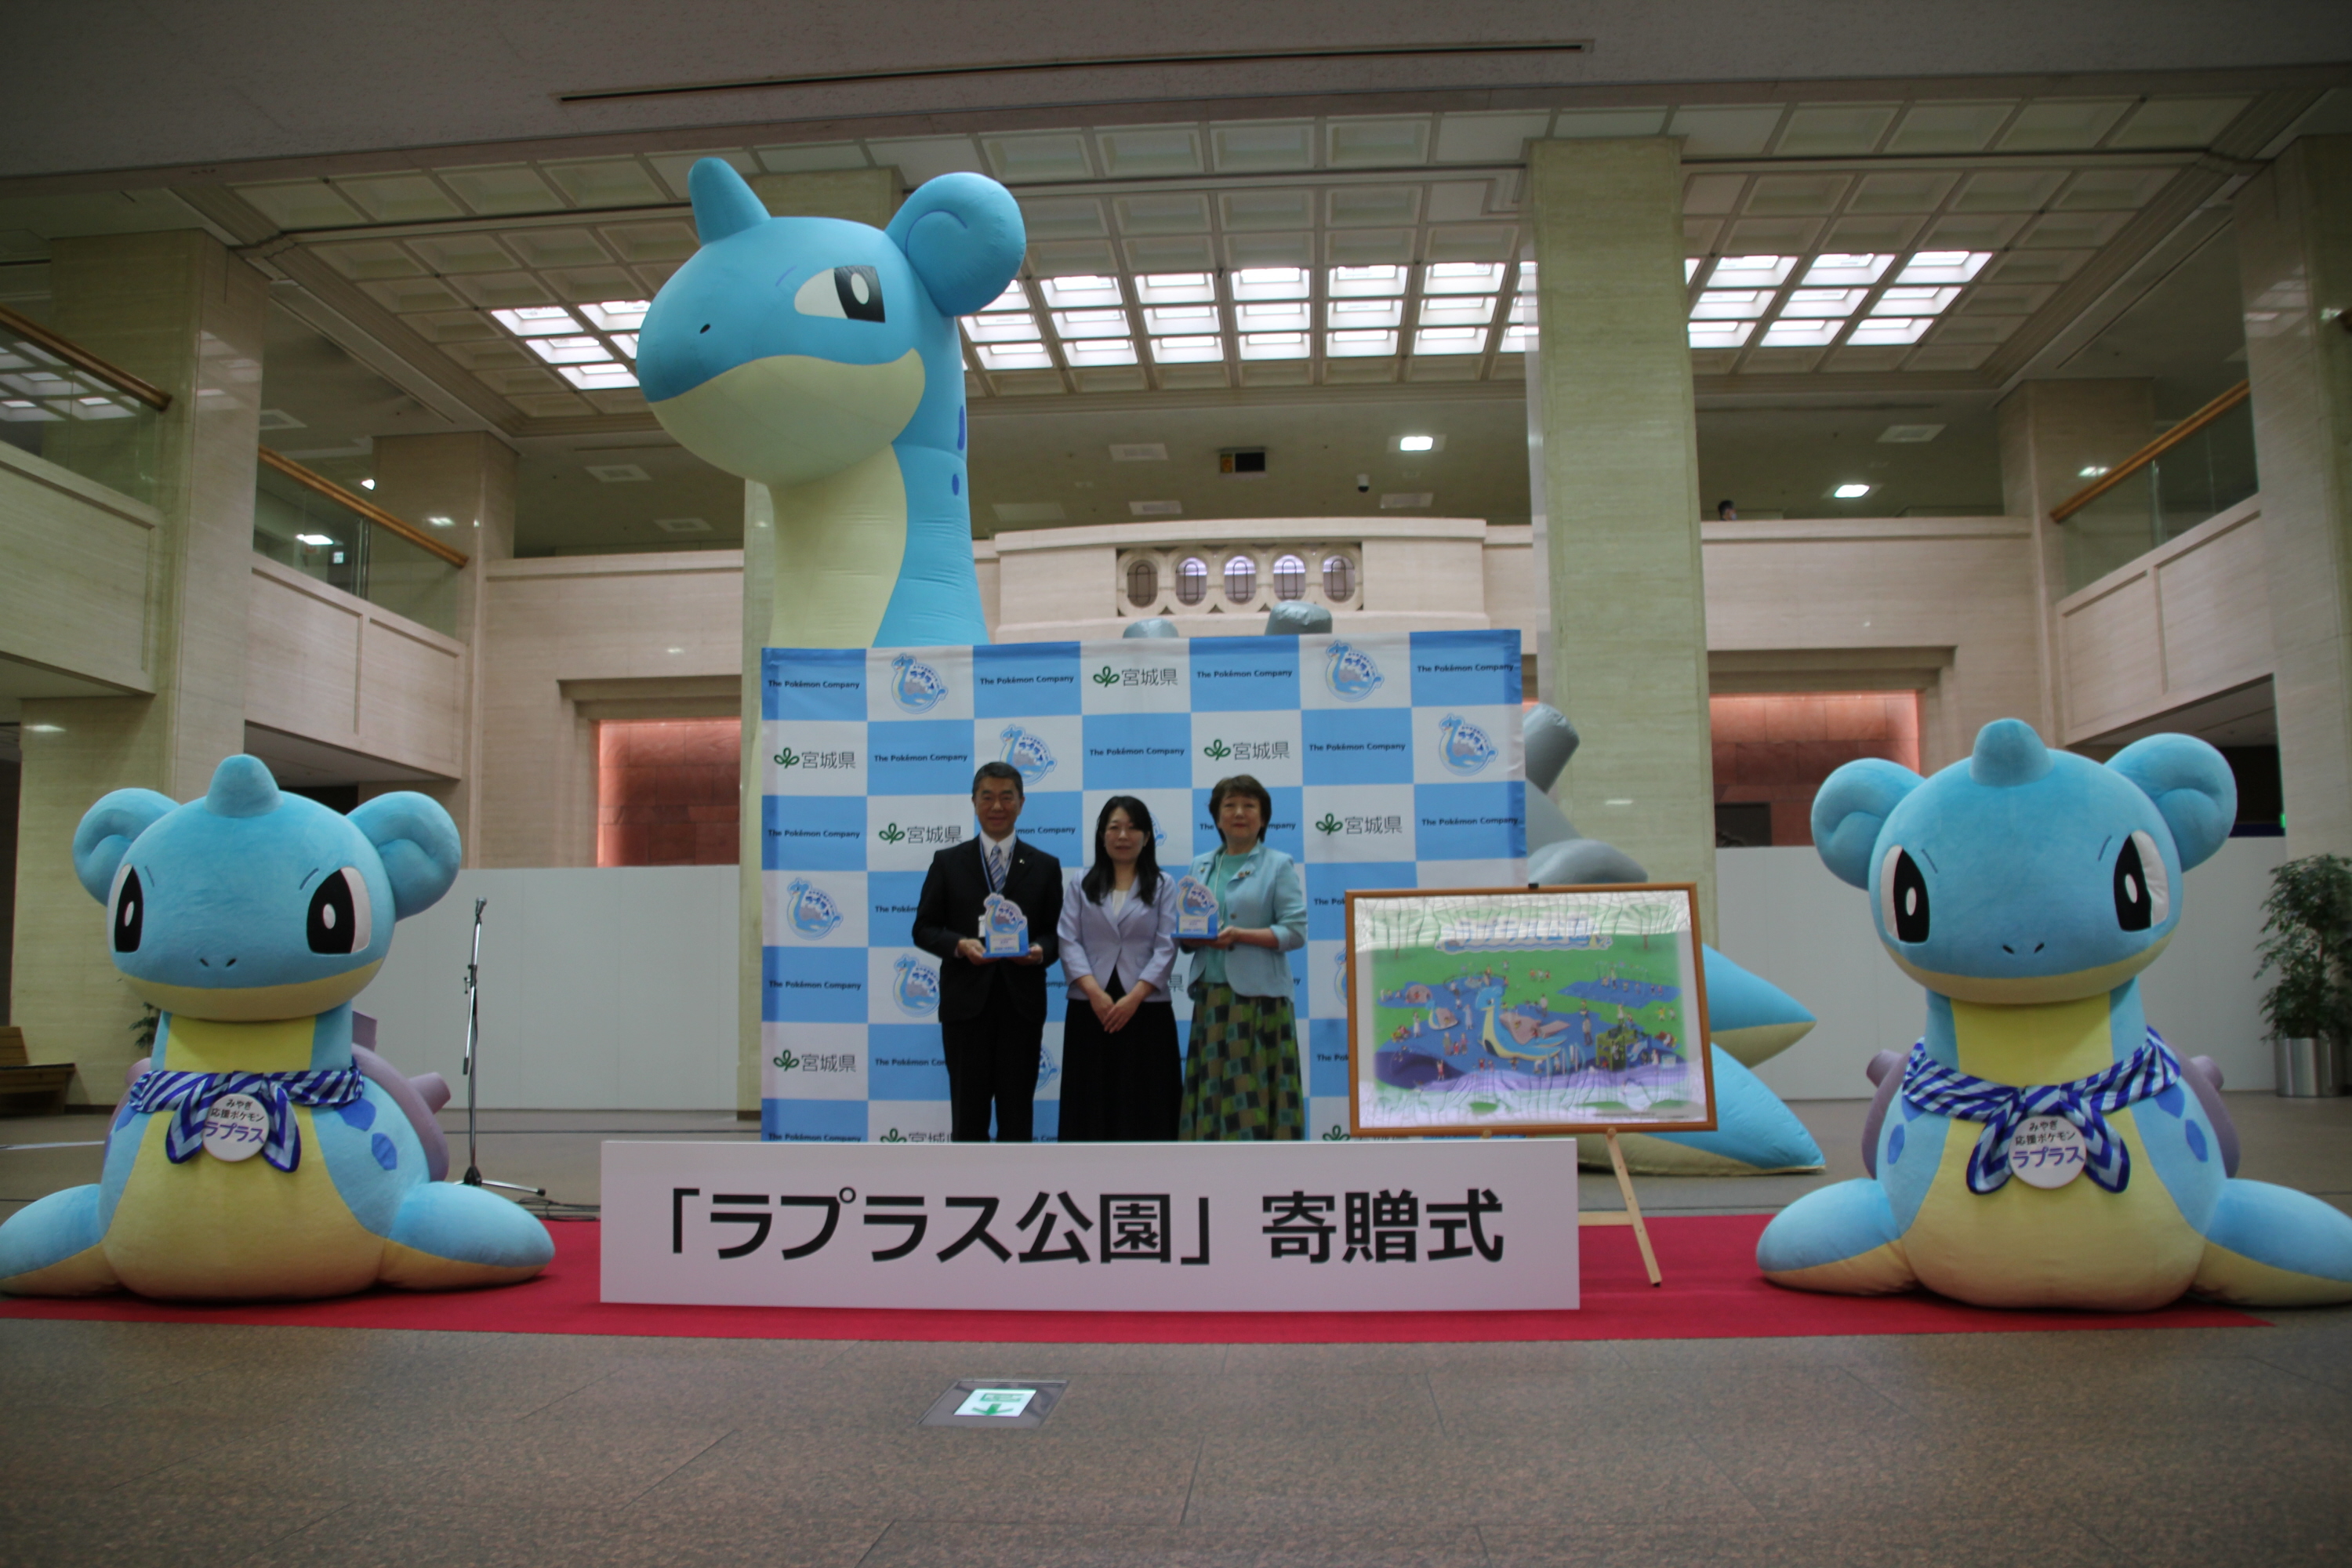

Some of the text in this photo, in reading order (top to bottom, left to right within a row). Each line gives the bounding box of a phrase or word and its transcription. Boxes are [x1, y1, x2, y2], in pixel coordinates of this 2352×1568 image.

[1122, 668, 1178, 686] 宮城県
[1475, 663, 1514, 673] Company
[801, 751, 855, 769] 宮城県
[1233, 742, 1290, 760] 宮城県
[1345, 815, 1403, 834] 宮城県
[1480, 817, 1519, 826] Company
[768, 829, 781, 837] The
[823, 830, 860, 839] Company
[907, 826, 963, 844] 宮城県
[824, 982, 861, 990] Company
[801, 1054, 856, 1073] 宮城県
[226, 1098, 253, 1110] みやぎ
[210, 1108, 265, 1122] 応援ポケモン
[205, 1120, 264, 1144] ラプラス
[2029, 1120, 2058, 1131] みやぎ
[2015, 1131, 2076, 1146] 応援ポケモン
[2013, 1146, 2084, 1168] ラプラス
[673, 1187, 1504, 1265] 「ラプラス公園」 寄贈式
